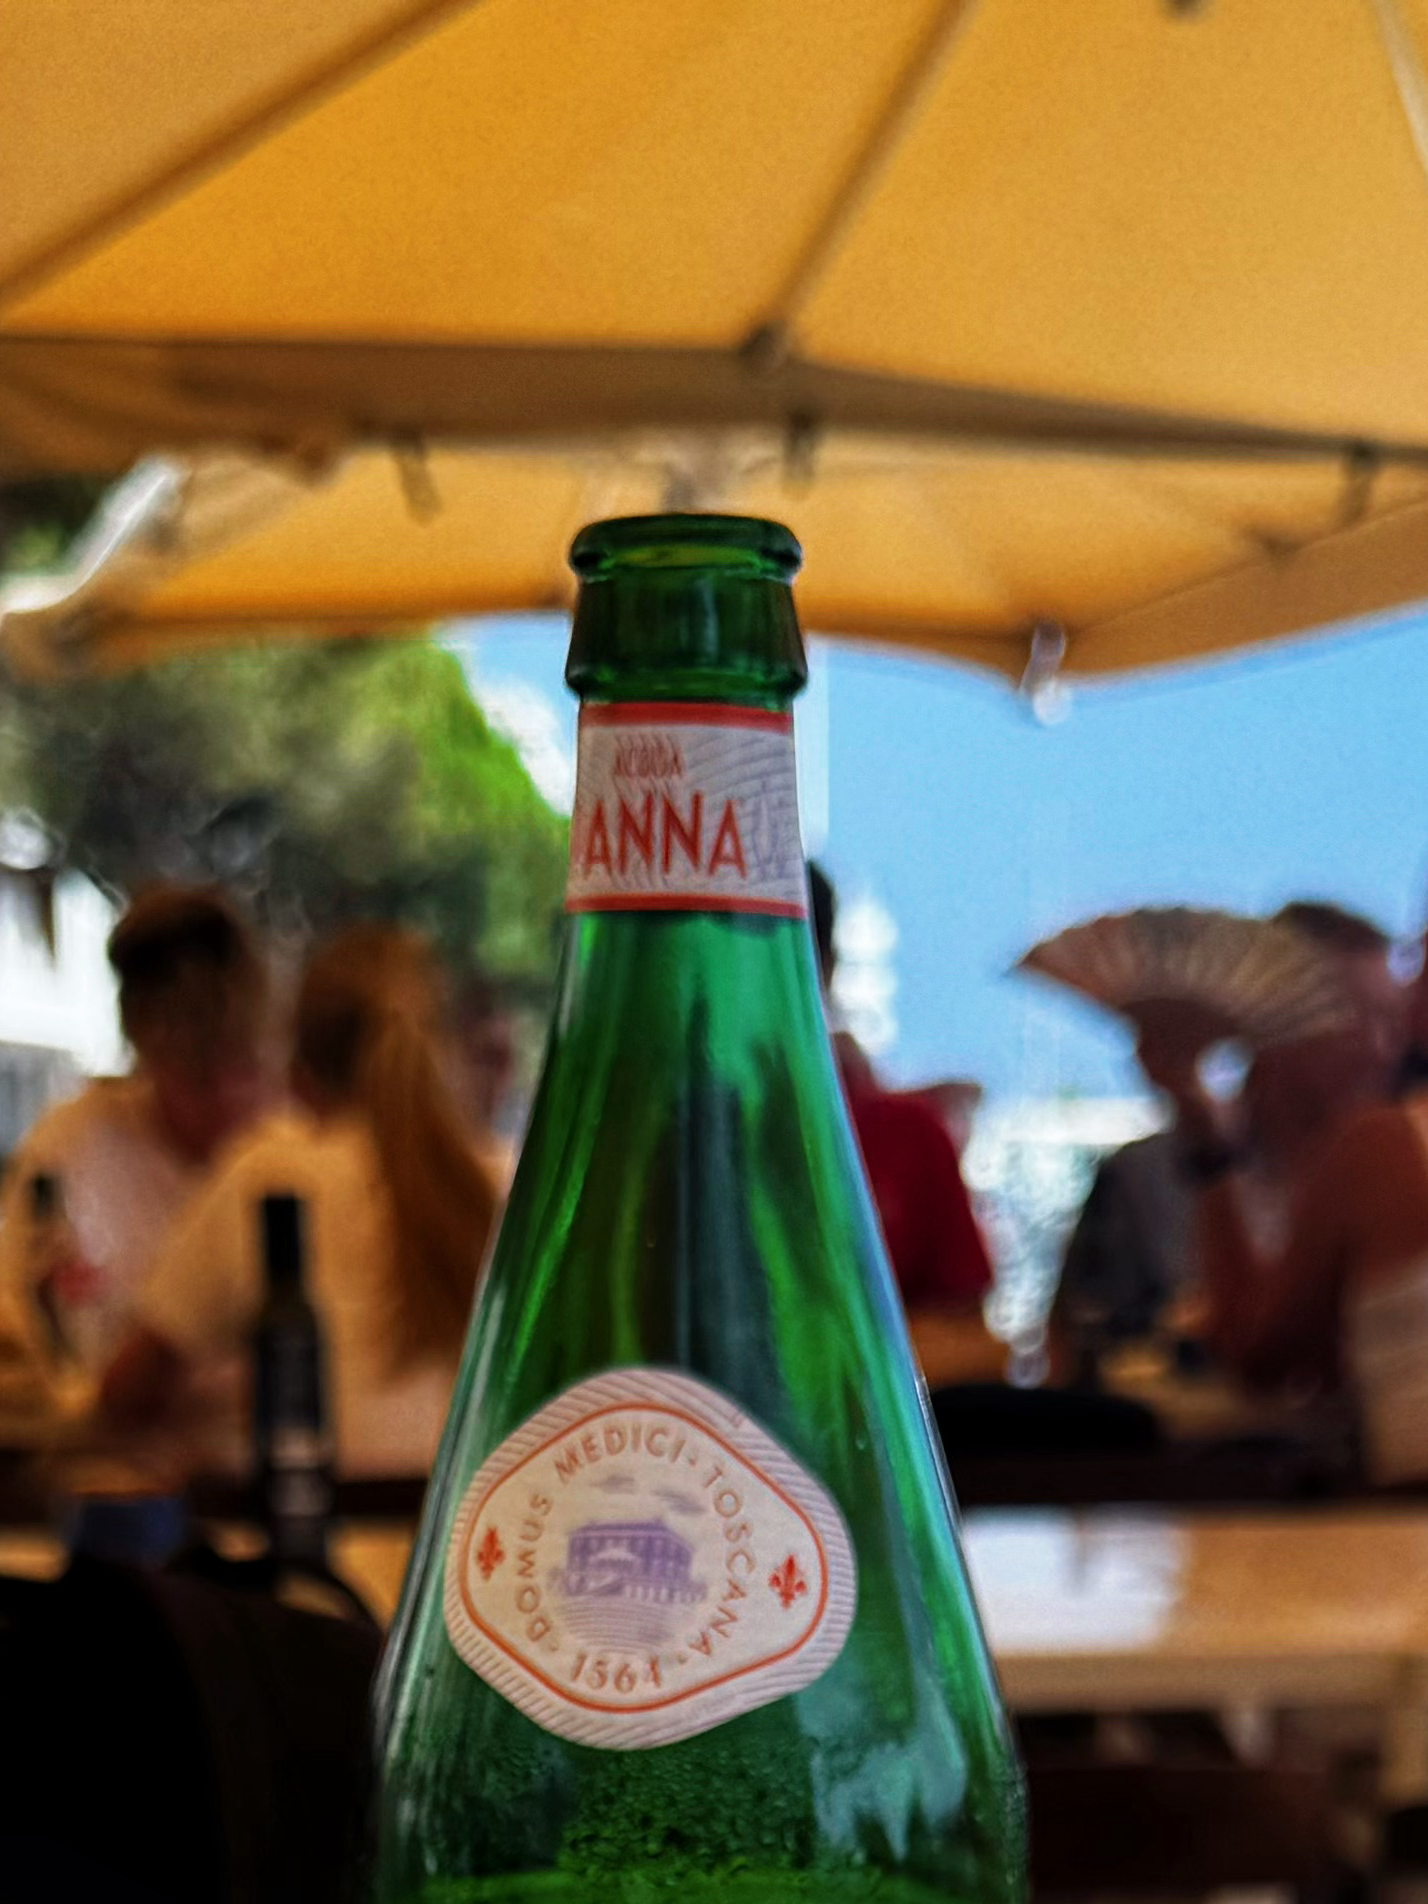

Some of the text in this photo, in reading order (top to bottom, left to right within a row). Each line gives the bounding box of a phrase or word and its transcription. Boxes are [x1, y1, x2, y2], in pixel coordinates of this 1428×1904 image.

[579, 788, 748, 881] ANNA
[514, 1422, 756, 1658] DOMUS MEDICI TOSCANA
